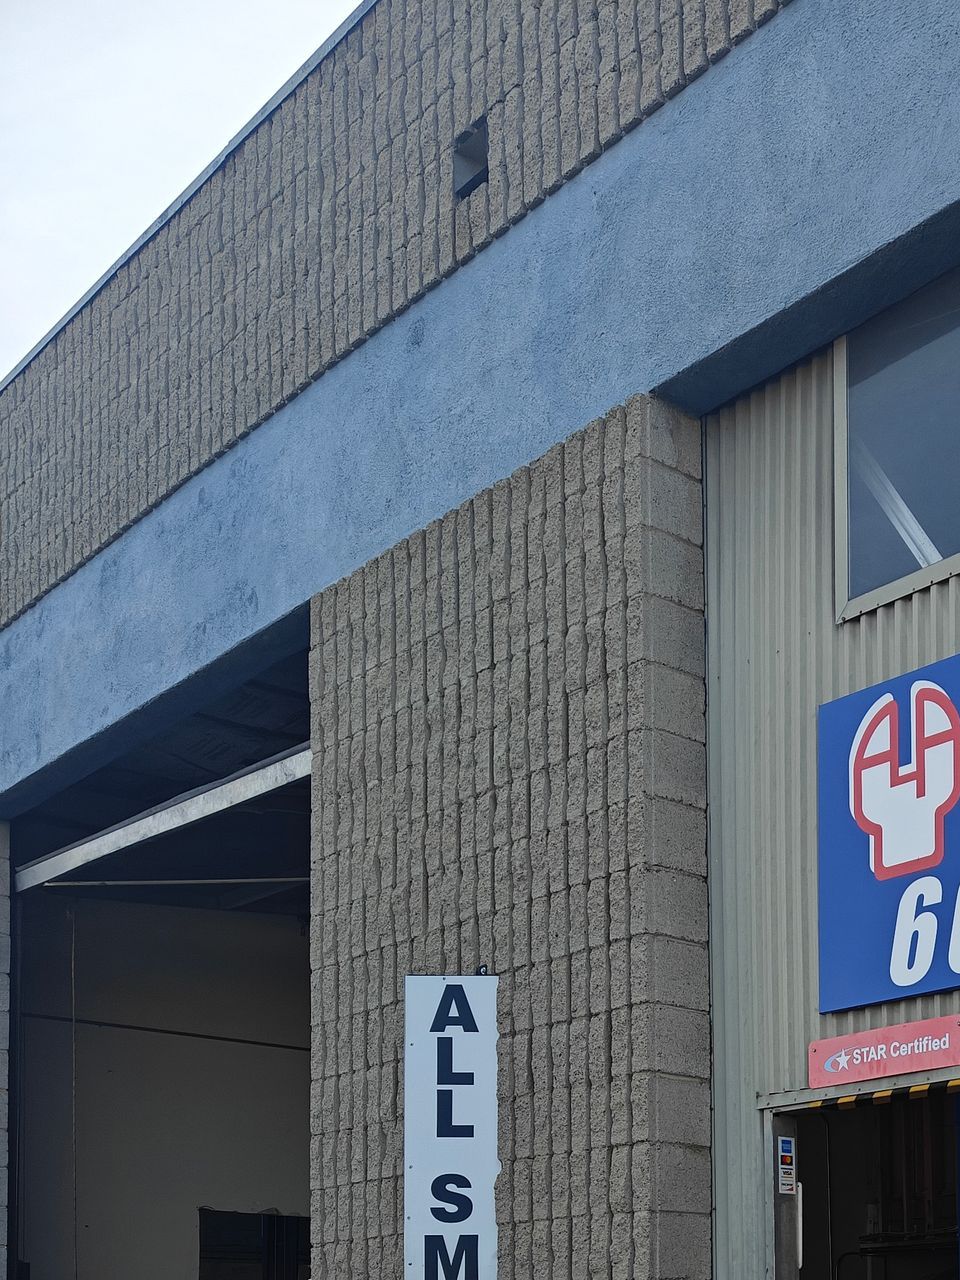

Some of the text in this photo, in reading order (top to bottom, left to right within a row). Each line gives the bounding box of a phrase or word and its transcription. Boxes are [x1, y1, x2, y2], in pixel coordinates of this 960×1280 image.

[429, 984, 480, 1138] ALL
[852, 1033, 950, 1065] STAR Certified
